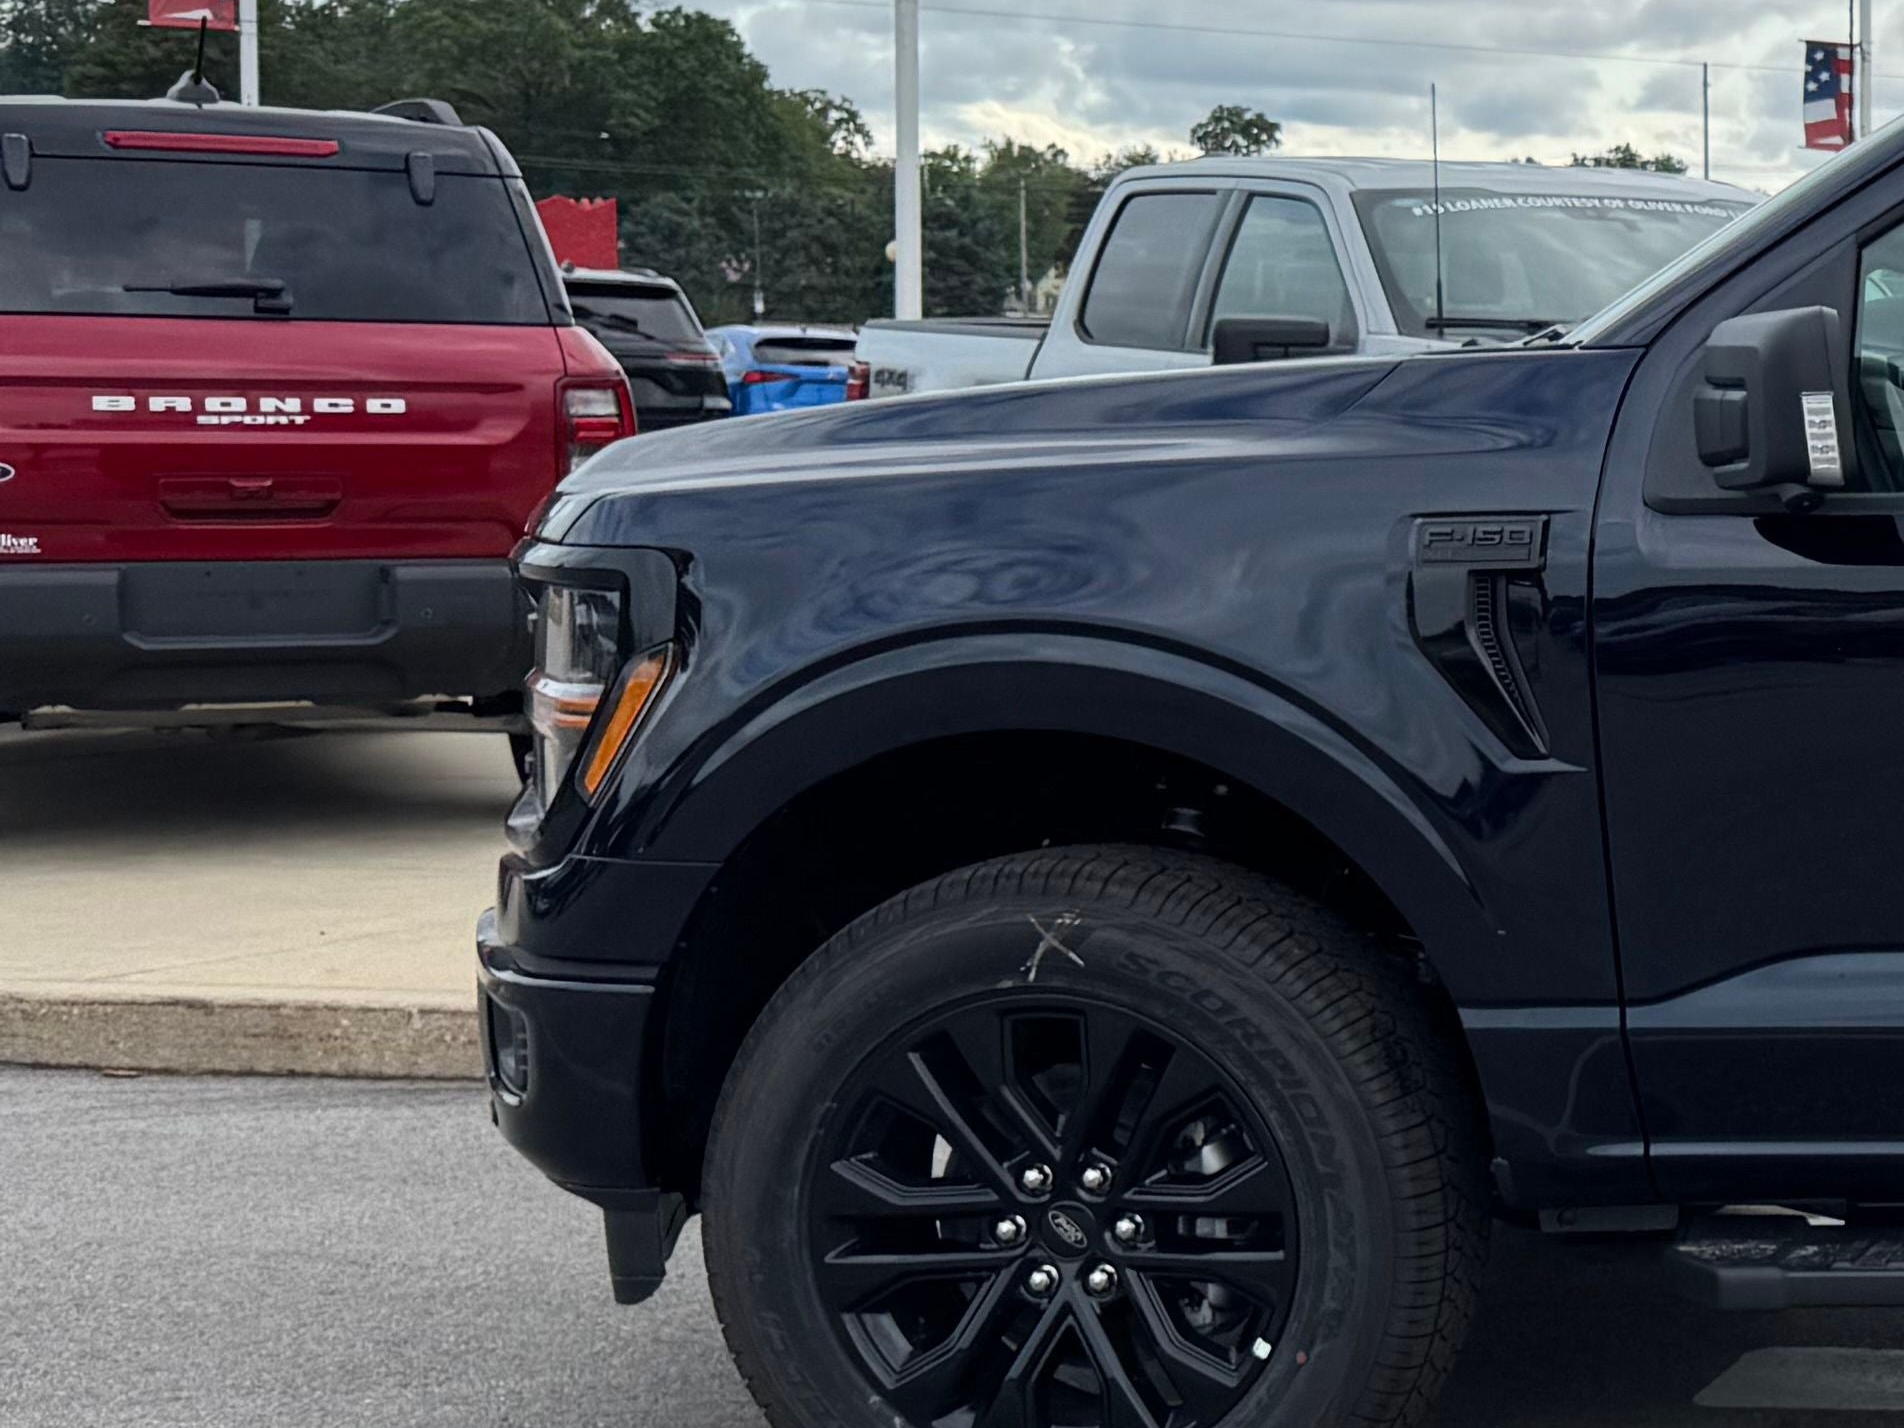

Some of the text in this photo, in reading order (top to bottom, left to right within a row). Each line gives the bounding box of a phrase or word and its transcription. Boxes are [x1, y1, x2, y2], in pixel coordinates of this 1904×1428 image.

[92, 395, 406, 414] BRONCO
[196, 415, 310, 425] SPORT
[0, 533, 38, 547] liver
[1423, 526, 1534, 547] F-150
[1117, 952, 1345, 1174] SCORPION
